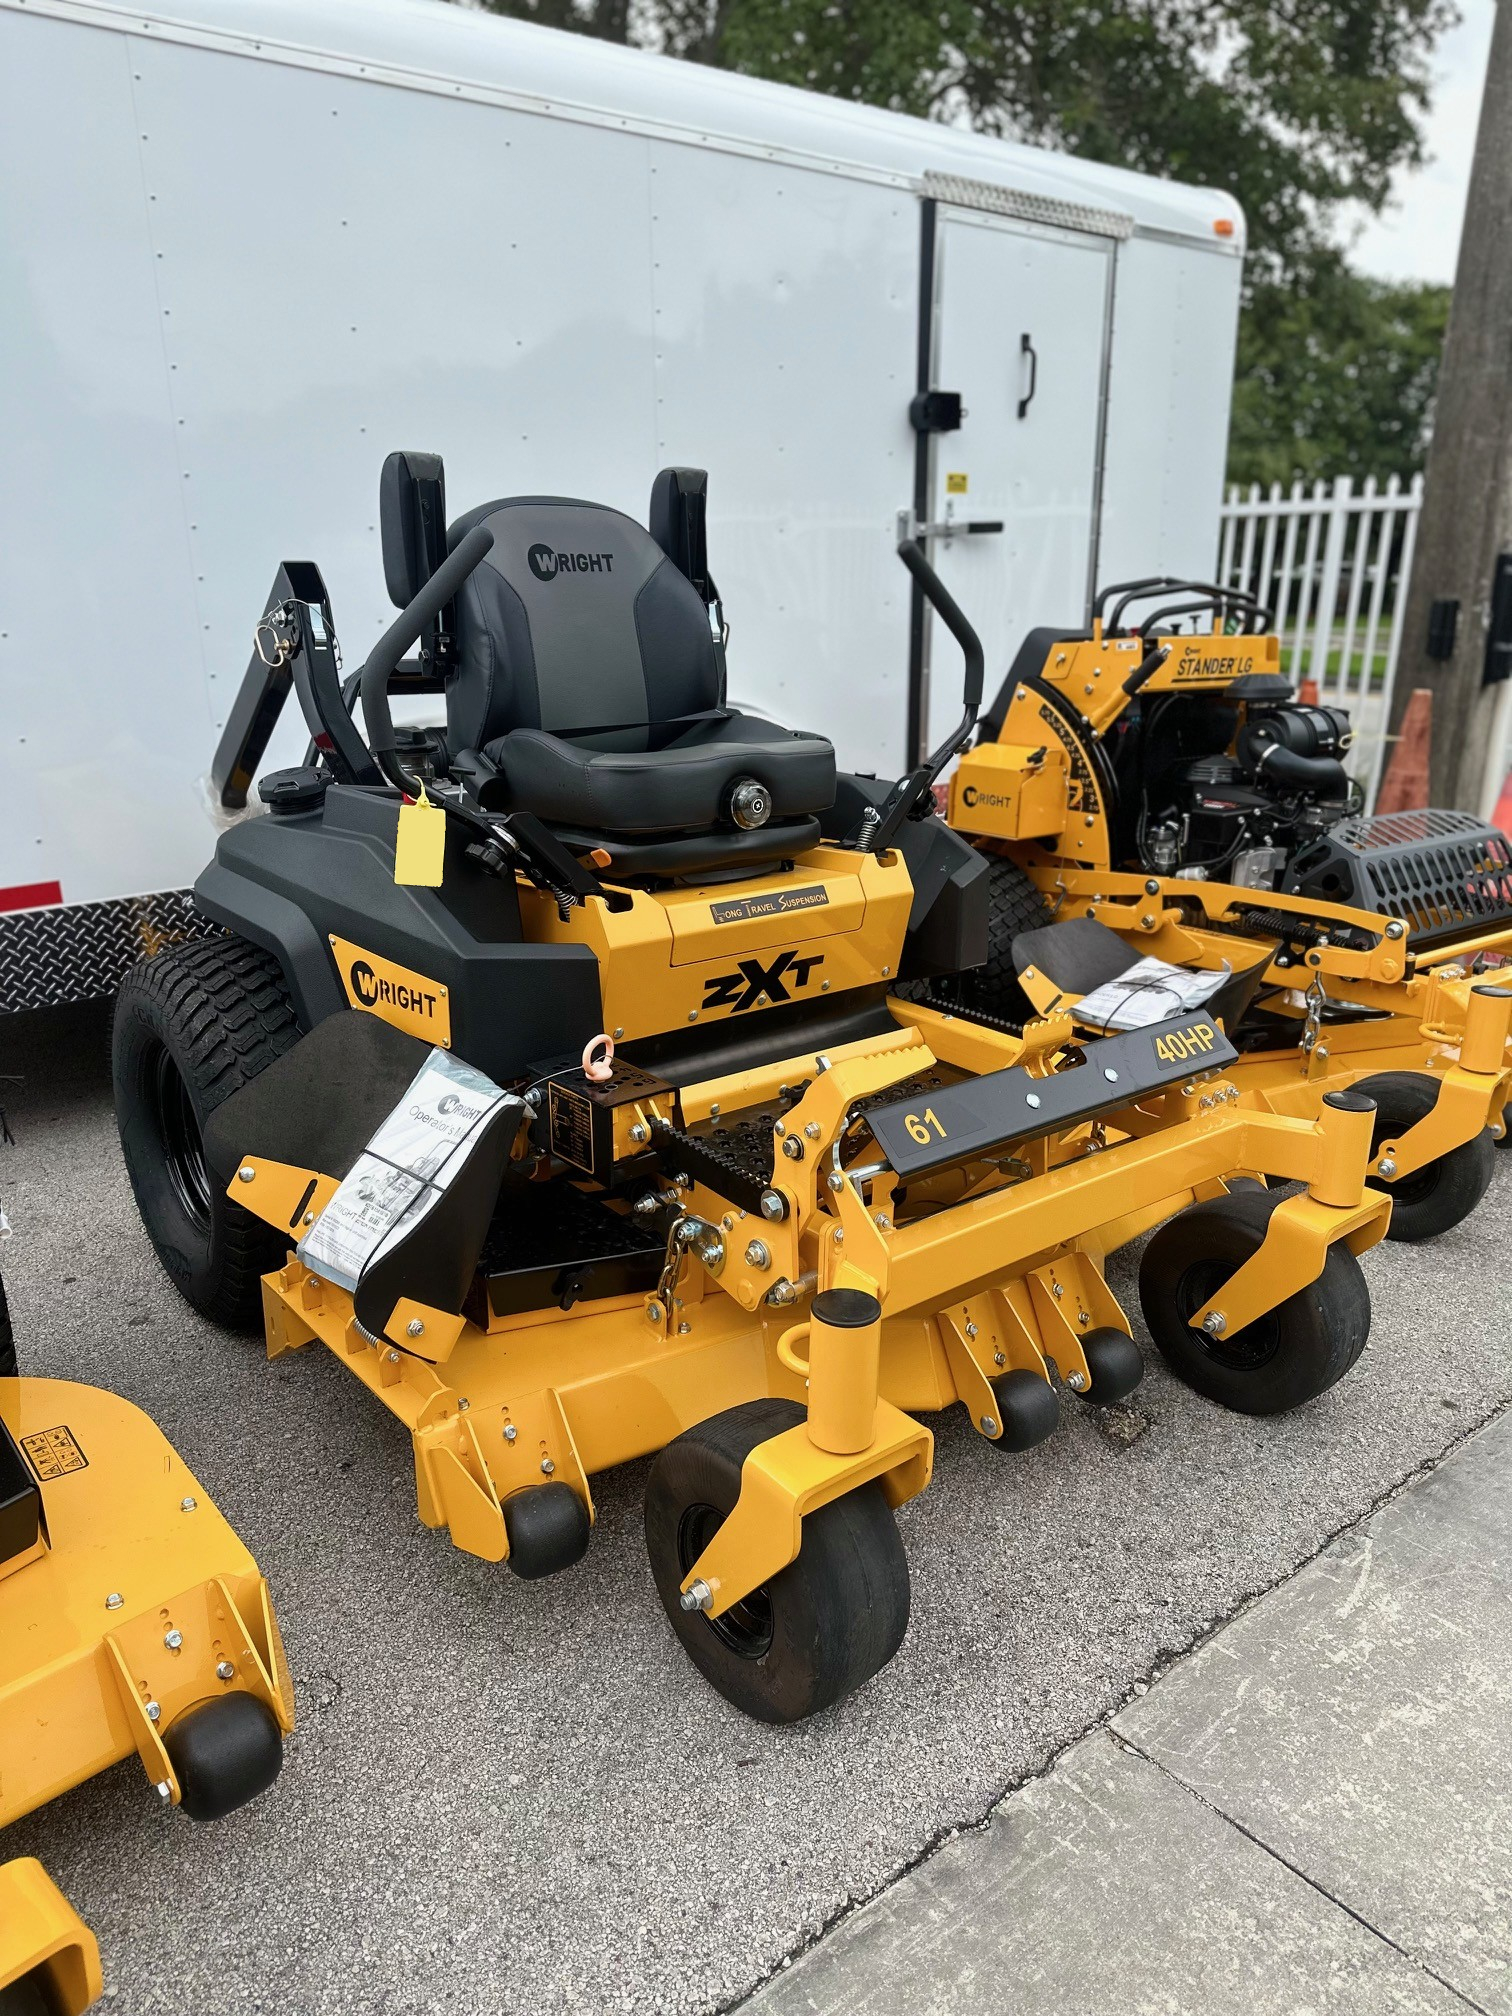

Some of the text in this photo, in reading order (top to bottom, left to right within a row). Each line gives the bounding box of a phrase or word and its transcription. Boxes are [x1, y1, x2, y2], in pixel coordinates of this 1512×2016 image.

[527, 543, 614, 582] WRIGHT
[1177, 656, 1254, 677] STANDER LG
[963, 785, 1012, 808] WRIGHT
[740, 900, 776, 917] TRAVEL
[778, 894, 827, 912] SUSPENSION
[350, 960, 437, 1019] WRIGHT
[701, 949, 825, 1014] ZXT
[1155, 1023, 1215, 1063] 40HP
[409, 1105, 456, 1137] Operator's
[437, 1093, 483, 1121] WRIGHT
[904, 1108, 948, 1145] 61
